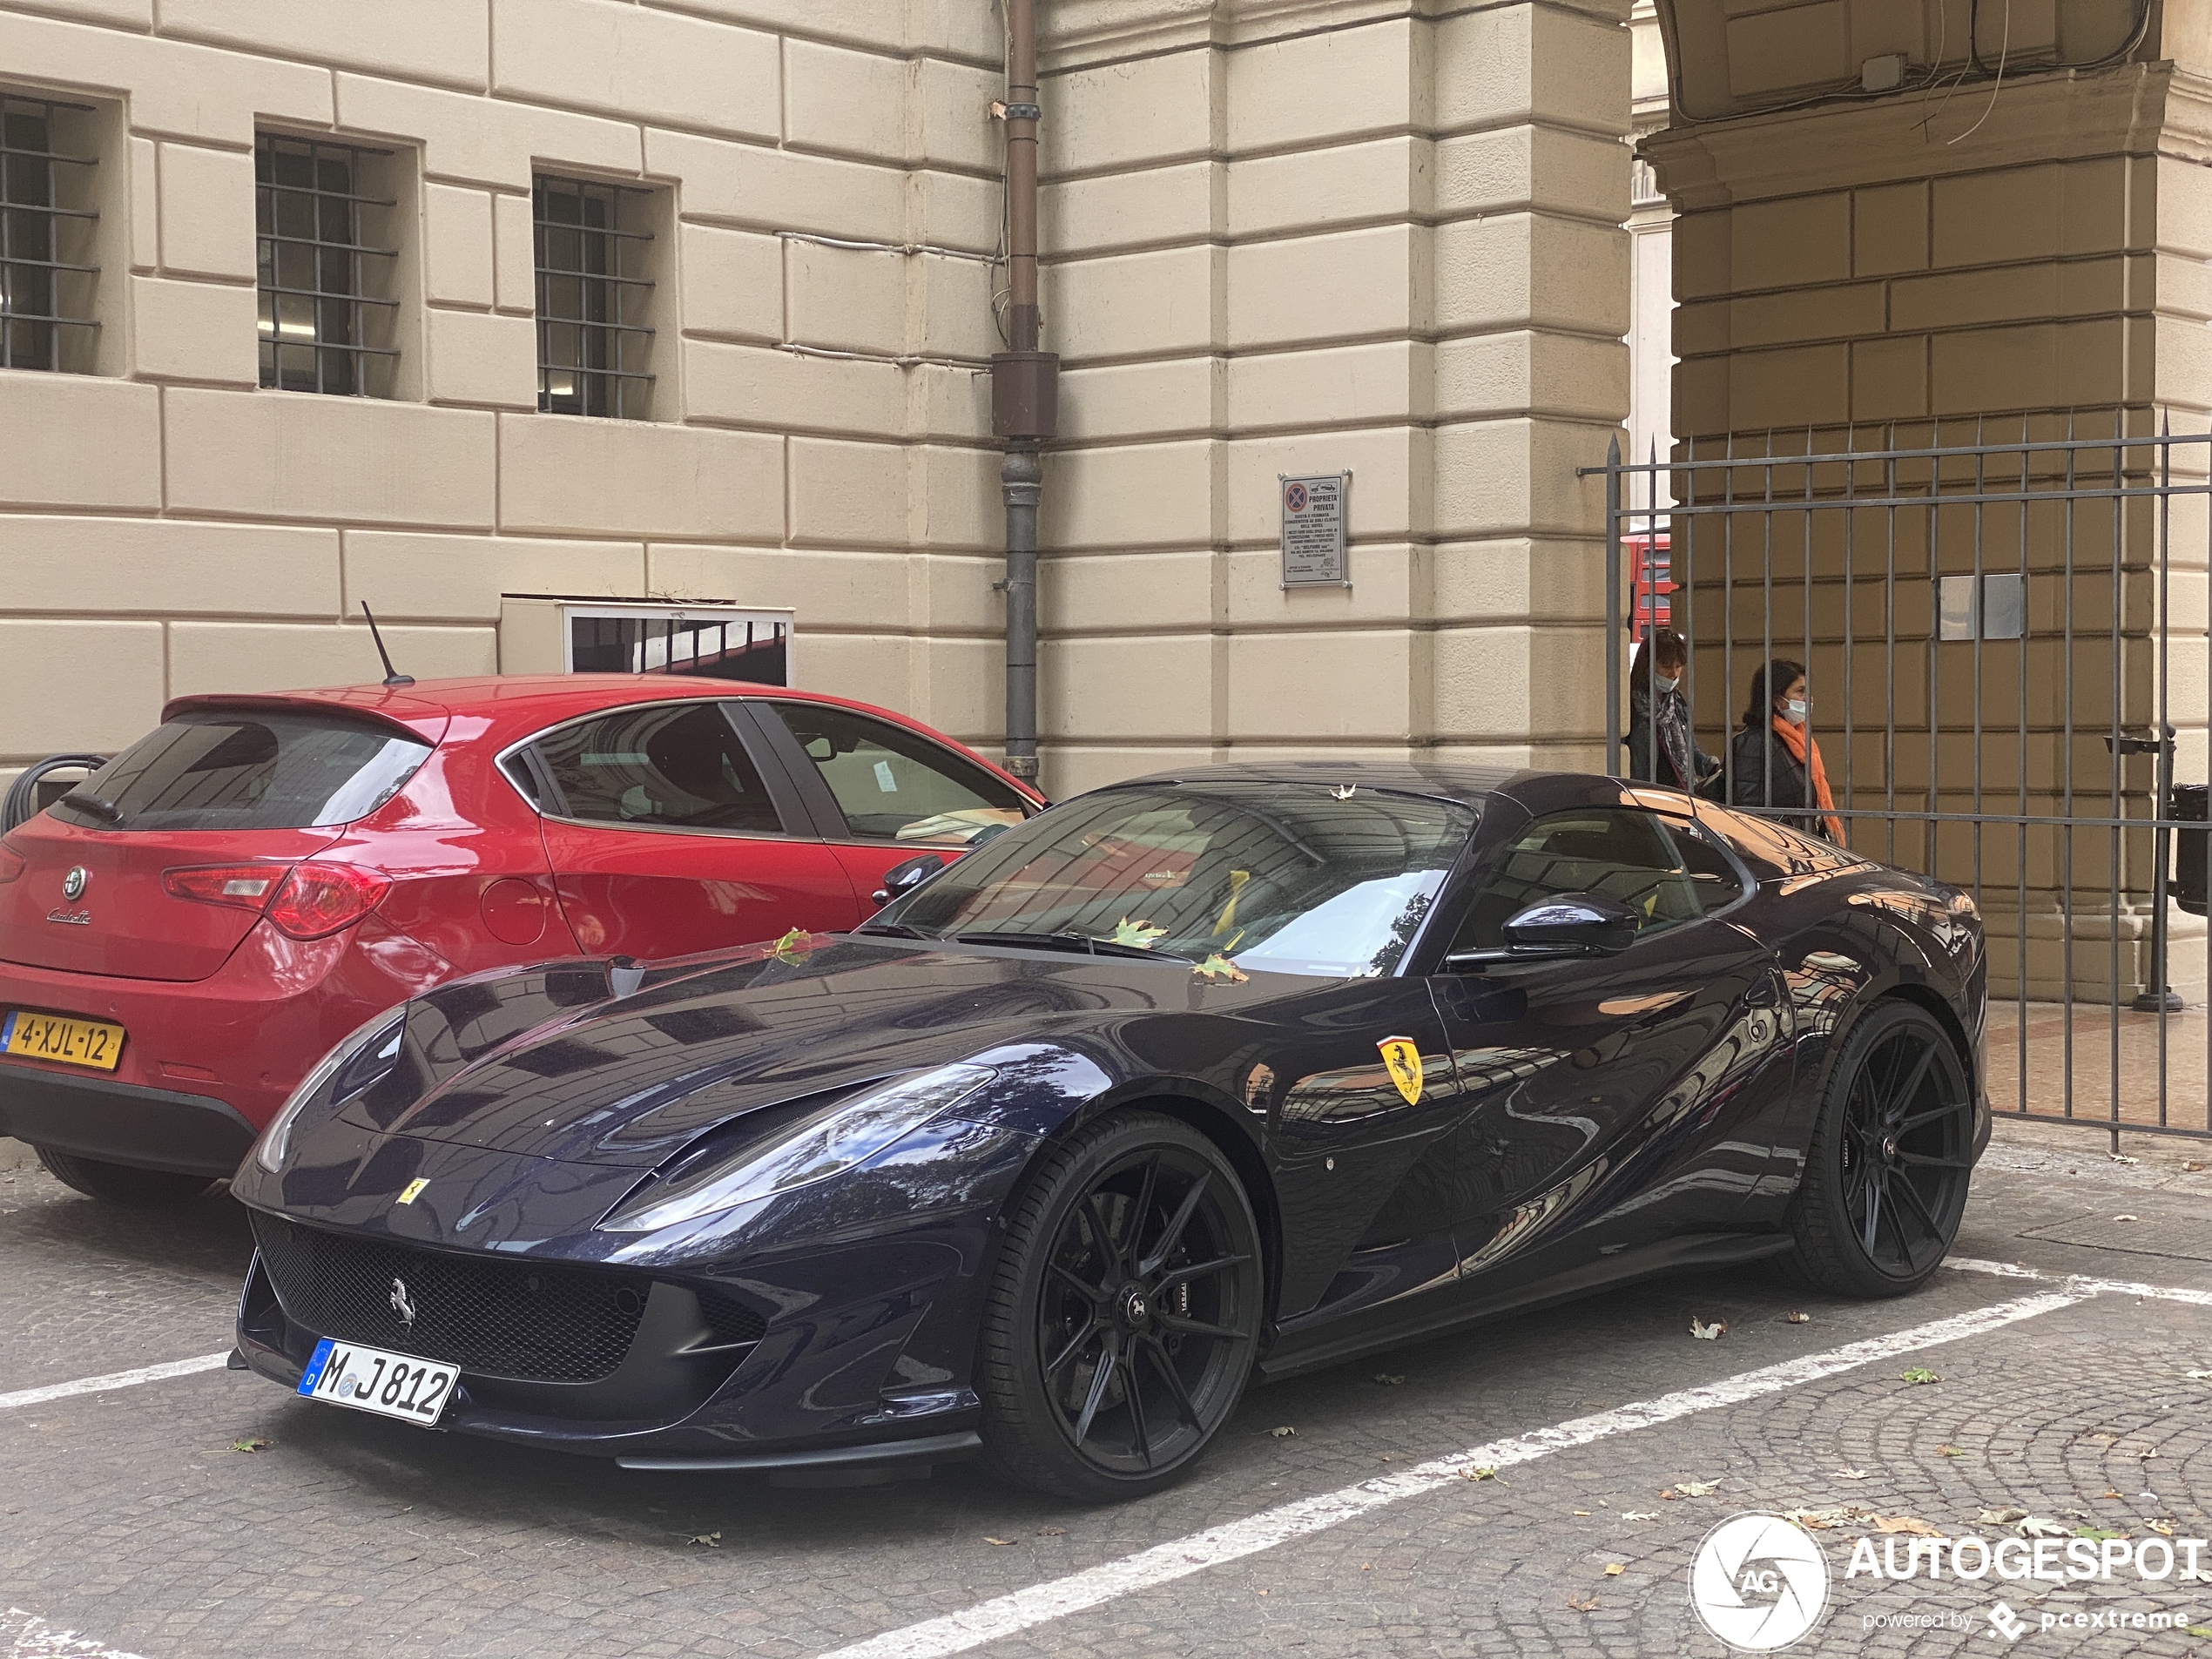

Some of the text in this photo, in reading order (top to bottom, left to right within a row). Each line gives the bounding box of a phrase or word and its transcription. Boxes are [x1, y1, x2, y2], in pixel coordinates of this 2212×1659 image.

[1309, 494, 1339, 502] PROPRIETA'
[21, 1019, 108, 1061] 4-XJL-12
[306, 1373, 315, 1386] D
[317, 1349, 351, 1393] M
